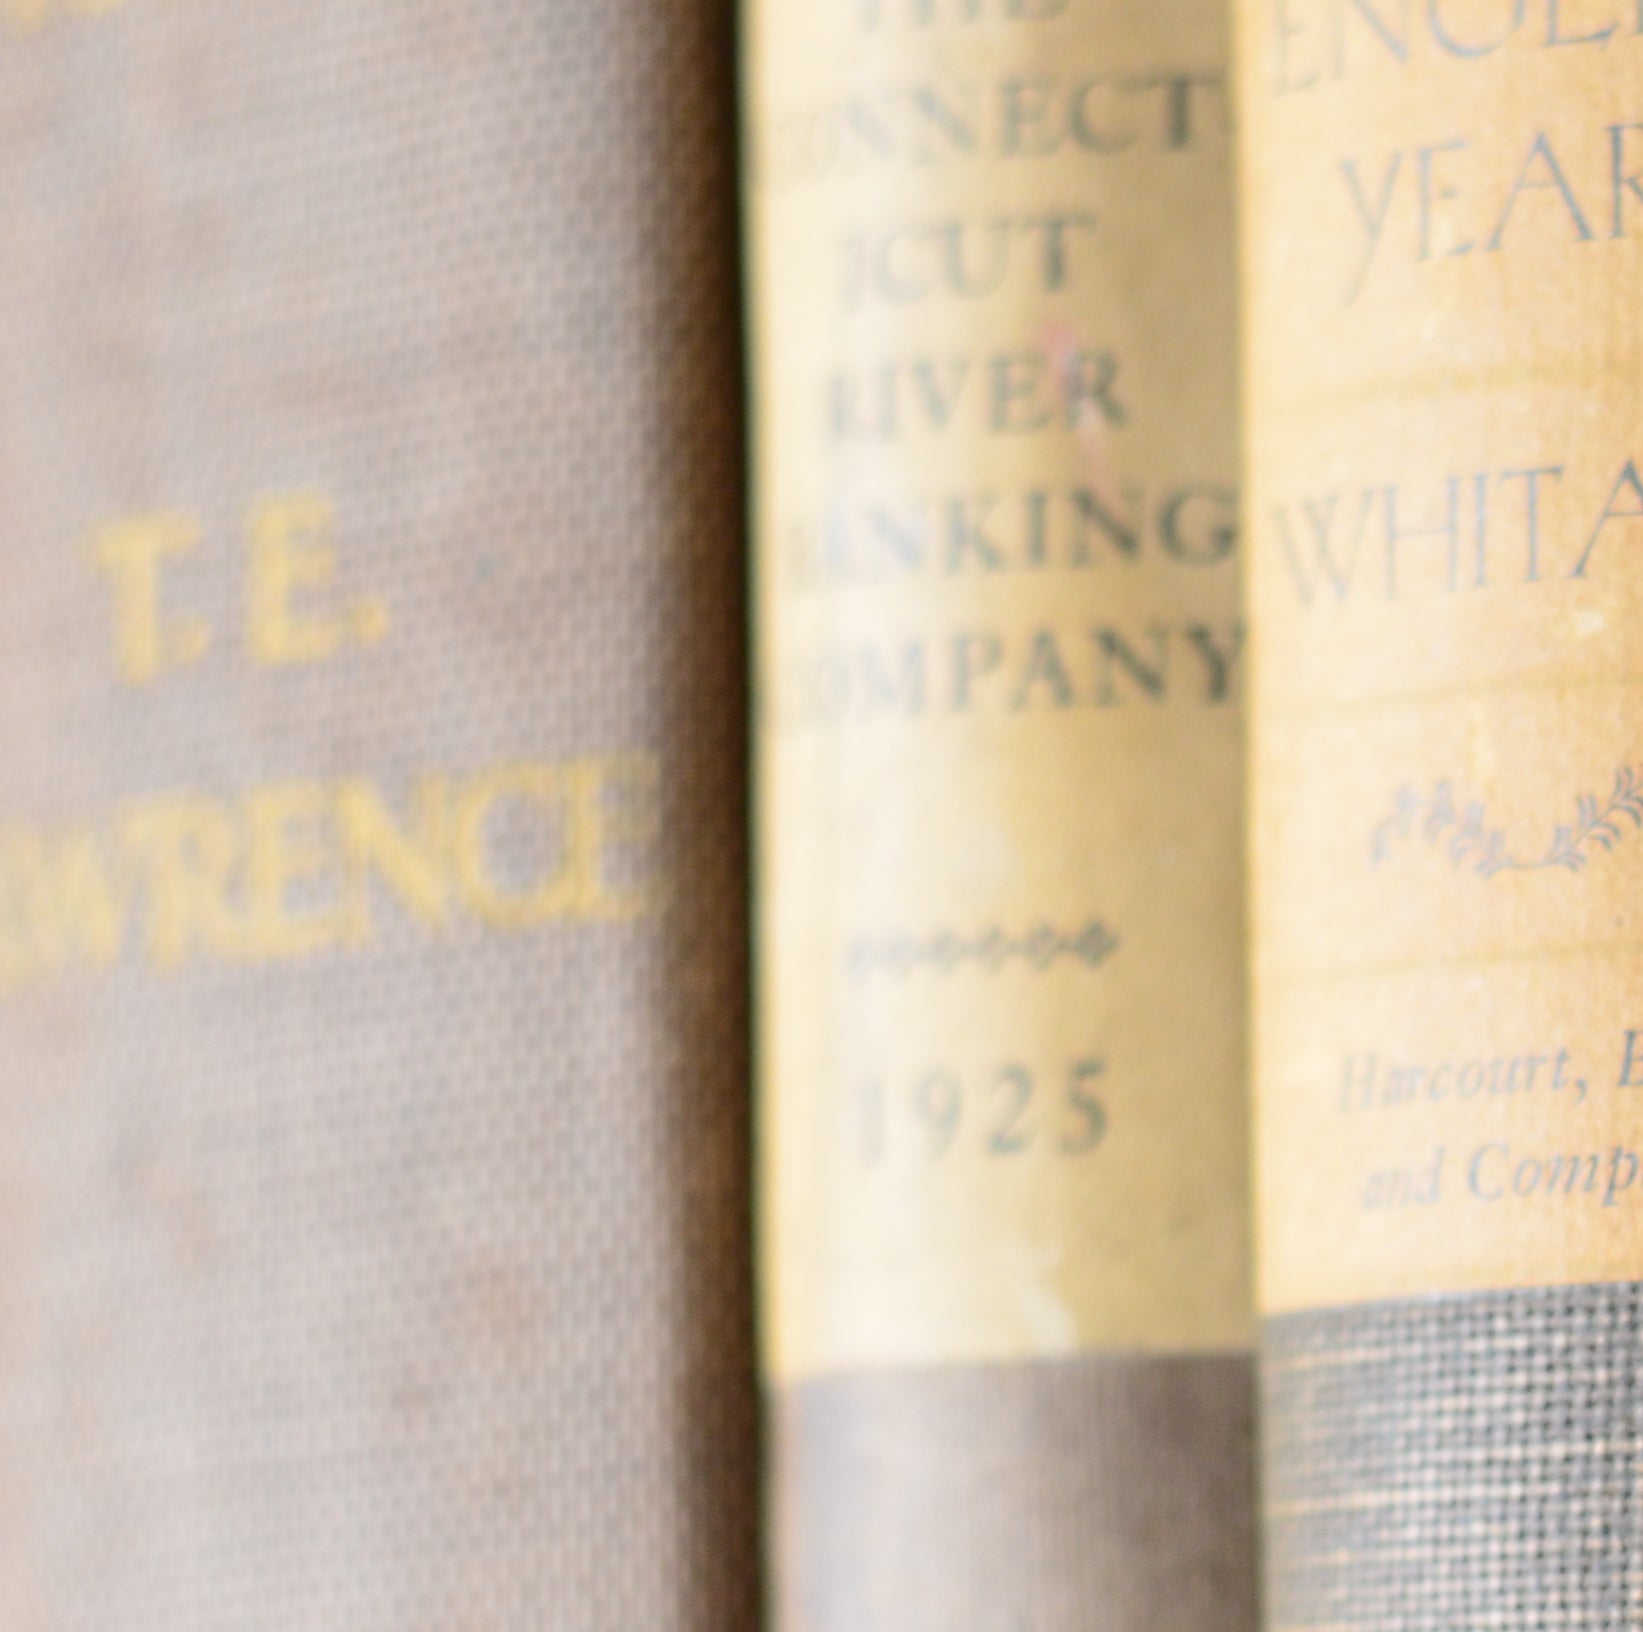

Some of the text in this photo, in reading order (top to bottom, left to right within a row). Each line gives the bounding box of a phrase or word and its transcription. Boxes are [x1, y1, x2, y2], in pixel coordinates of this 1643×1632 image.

[856, 1056, 1112, 1161] 1925
[1338, 1043, 1590, 1113] Harcourt,
[1360, 1147, 1447, 1211] and
